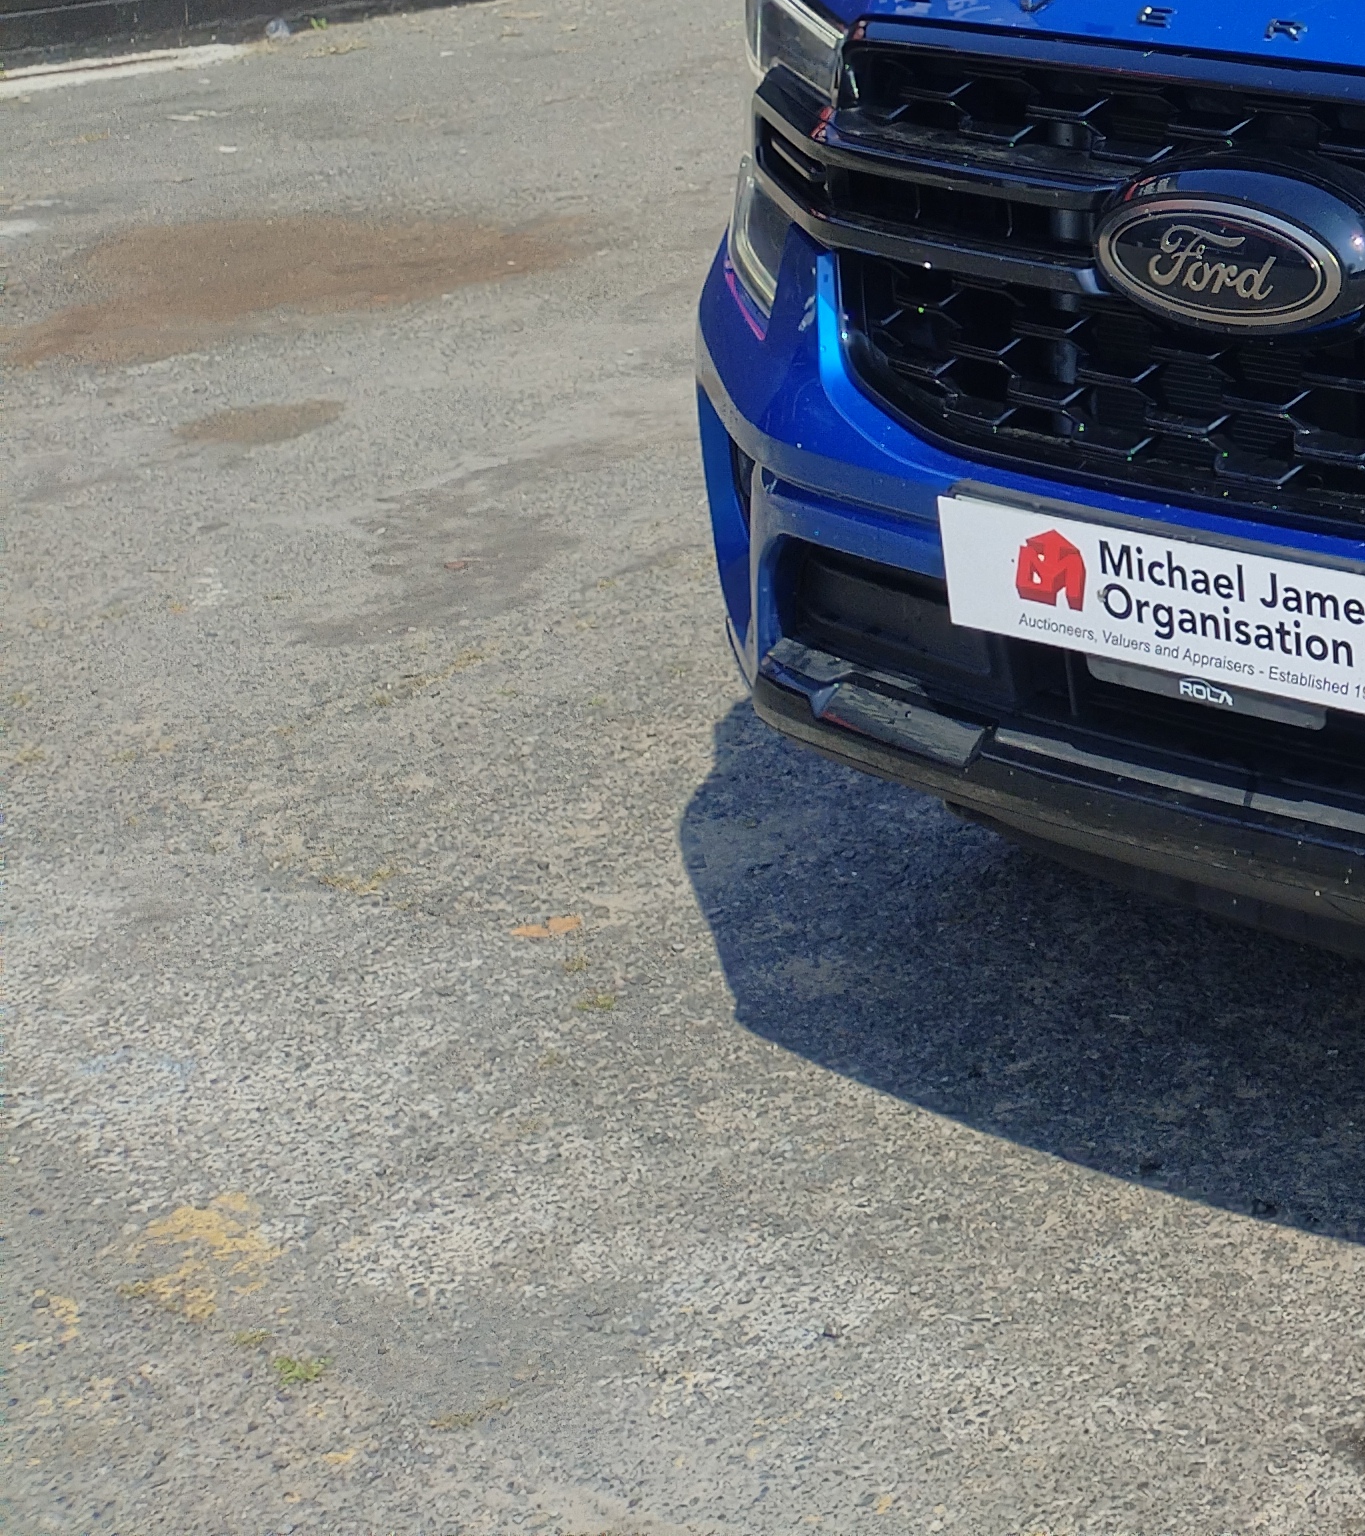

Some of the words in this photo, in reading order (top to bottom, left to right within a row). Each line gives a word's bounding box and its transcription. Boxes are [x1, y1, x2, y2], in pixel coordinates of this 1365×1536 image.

[1149, 223, 1275, 304] Ford
[1099, 540, 1246, 604] Michael
[1018, 613, 1099, 644] Auctioneers,
[1102, 629, 1151, 654] Valuers
[1154, 639, 1180, 661] and
[1182, 647, 1255, 677] Appraisers
[1269, 666, 1349, 697] Established
[1103, 583, 1355, 668] Organisation
[1179, 677, 1235, 707] ROLA
